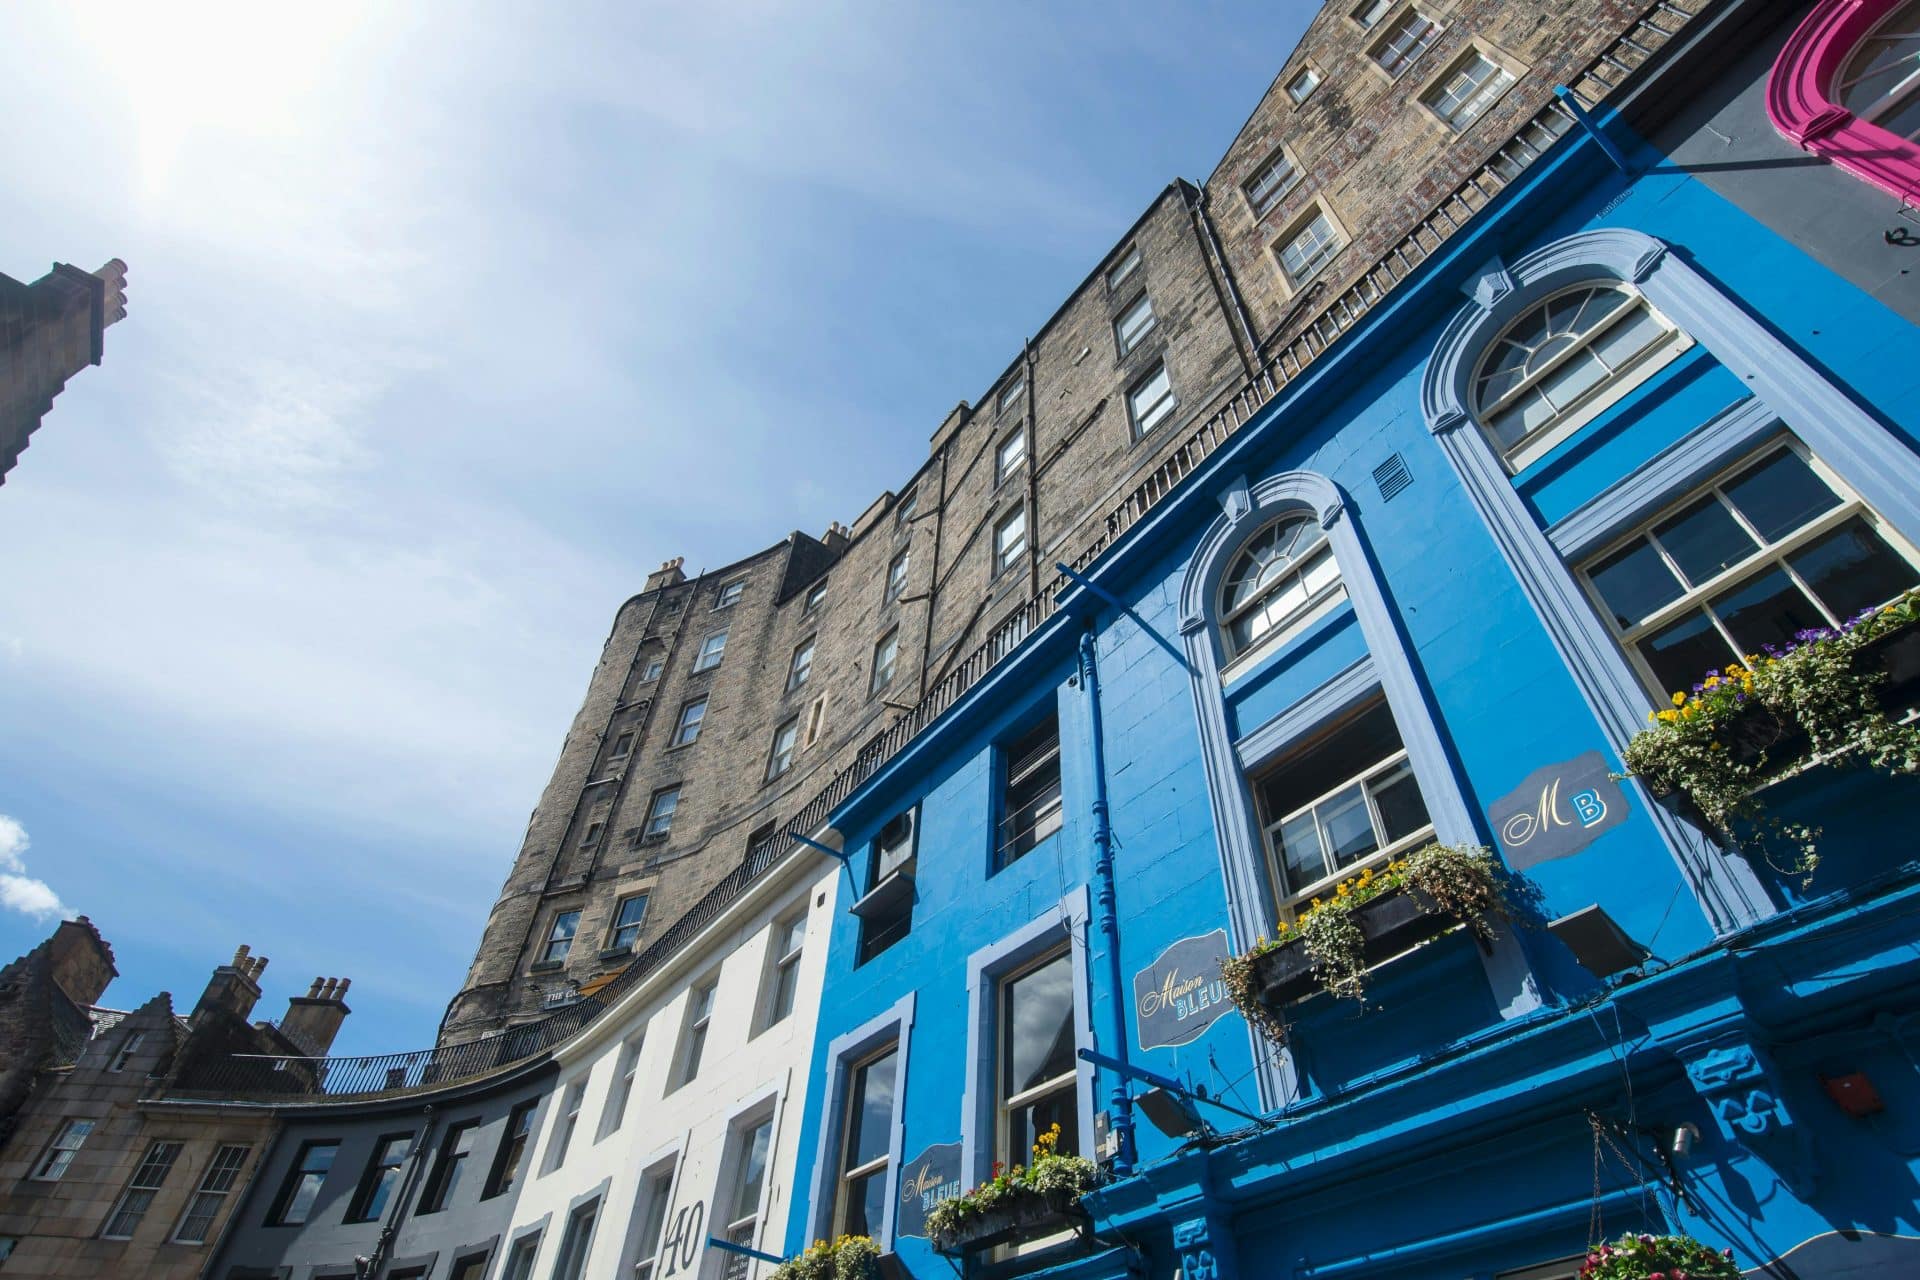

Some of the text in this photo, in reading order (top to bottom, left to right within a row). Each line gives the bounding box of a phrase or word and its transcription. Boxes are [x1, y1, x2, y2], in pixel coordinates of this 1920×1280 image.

[547, 991, 563, 1002] THE
[1140, 967, 1204, 1018] Maison
[902, 1162, 943, 1203] Maison
[664, 1200, 704, 1278] 40
